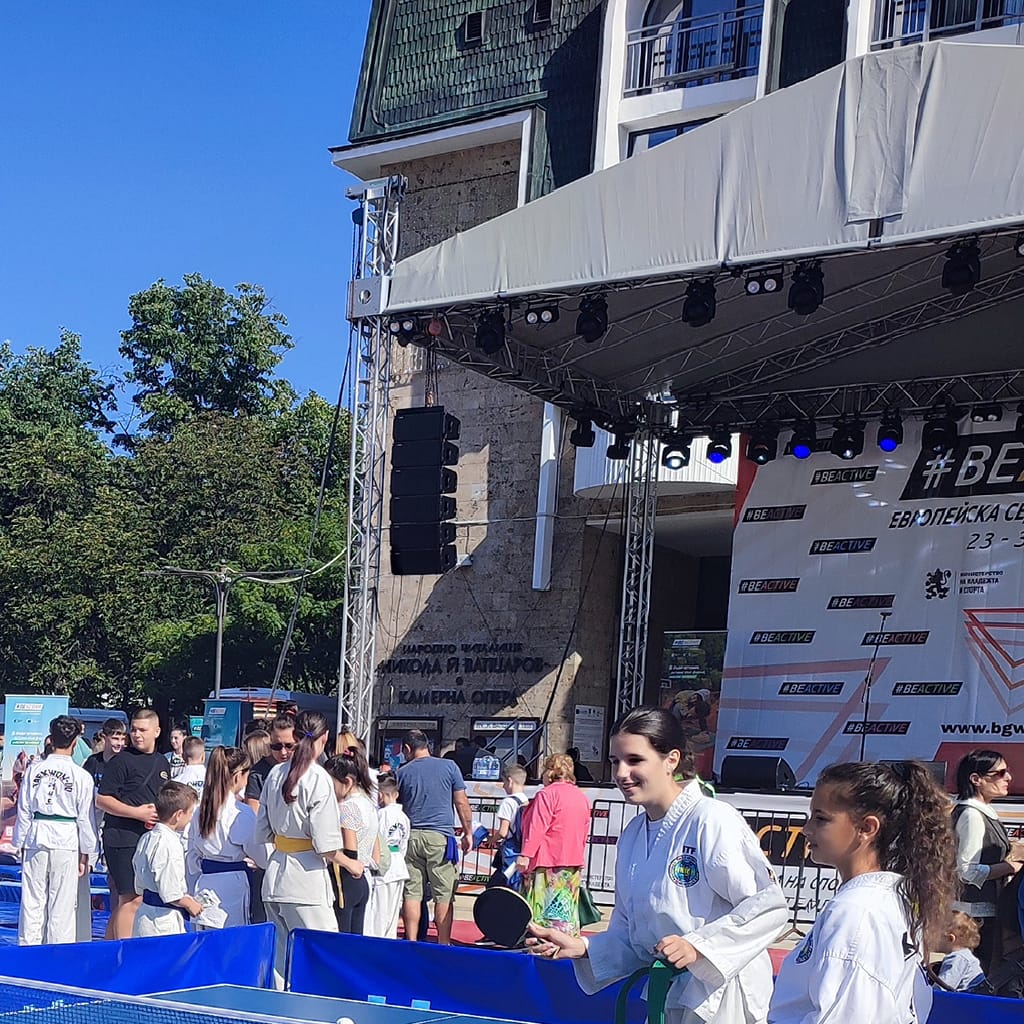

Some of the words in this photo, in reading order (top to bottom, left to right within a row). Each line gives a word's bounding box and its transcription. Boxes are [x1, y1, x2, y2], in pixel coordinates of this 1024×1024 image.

[922, 442, 1024, 490] #BE
[815, 468, 876, 483] #BEACTIVE
[813, 539, 872, 552] #BEACTIVE
[967, 532, 993, 550] 23
[741, 579, 797, 592] #BEACTIVE
[754, 632, 812, 643] #BEACTIVE
[865, 633, 927, 644] #BEACTIVE
[783, 683, 841, 694] #BEACTIVE
[896, 682, 959, 694] #BEACTIVE
[682, 845, 697, 855] ITF
